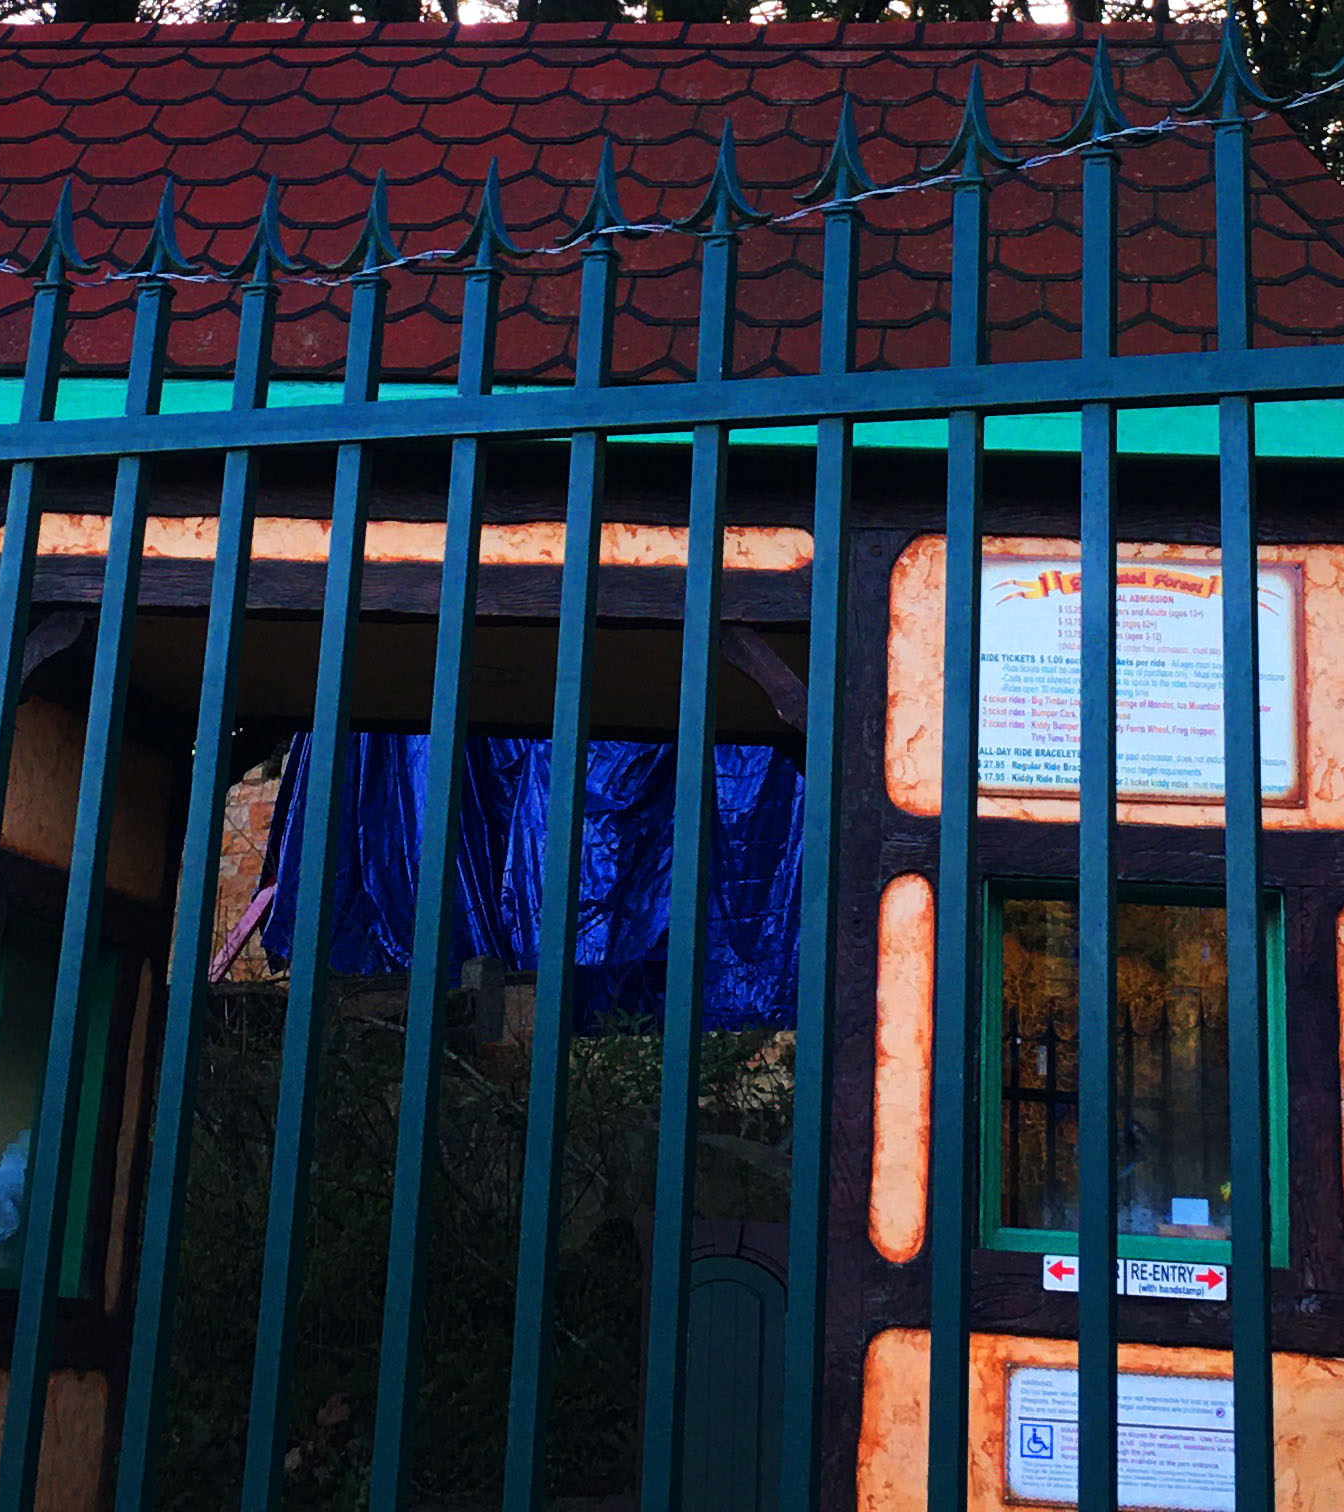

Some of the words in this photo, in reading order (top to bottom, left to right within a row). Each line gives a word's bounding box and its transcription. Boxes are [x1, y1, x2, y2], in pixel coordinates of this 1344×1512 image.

[980, 653, 999, 662] RIDE
[1001, 654, 1035, 663] TICKETS
[1014, 748, 1032, 757] RIDE
[1131, 1263, 1195, 1283] RE-ENTRY
